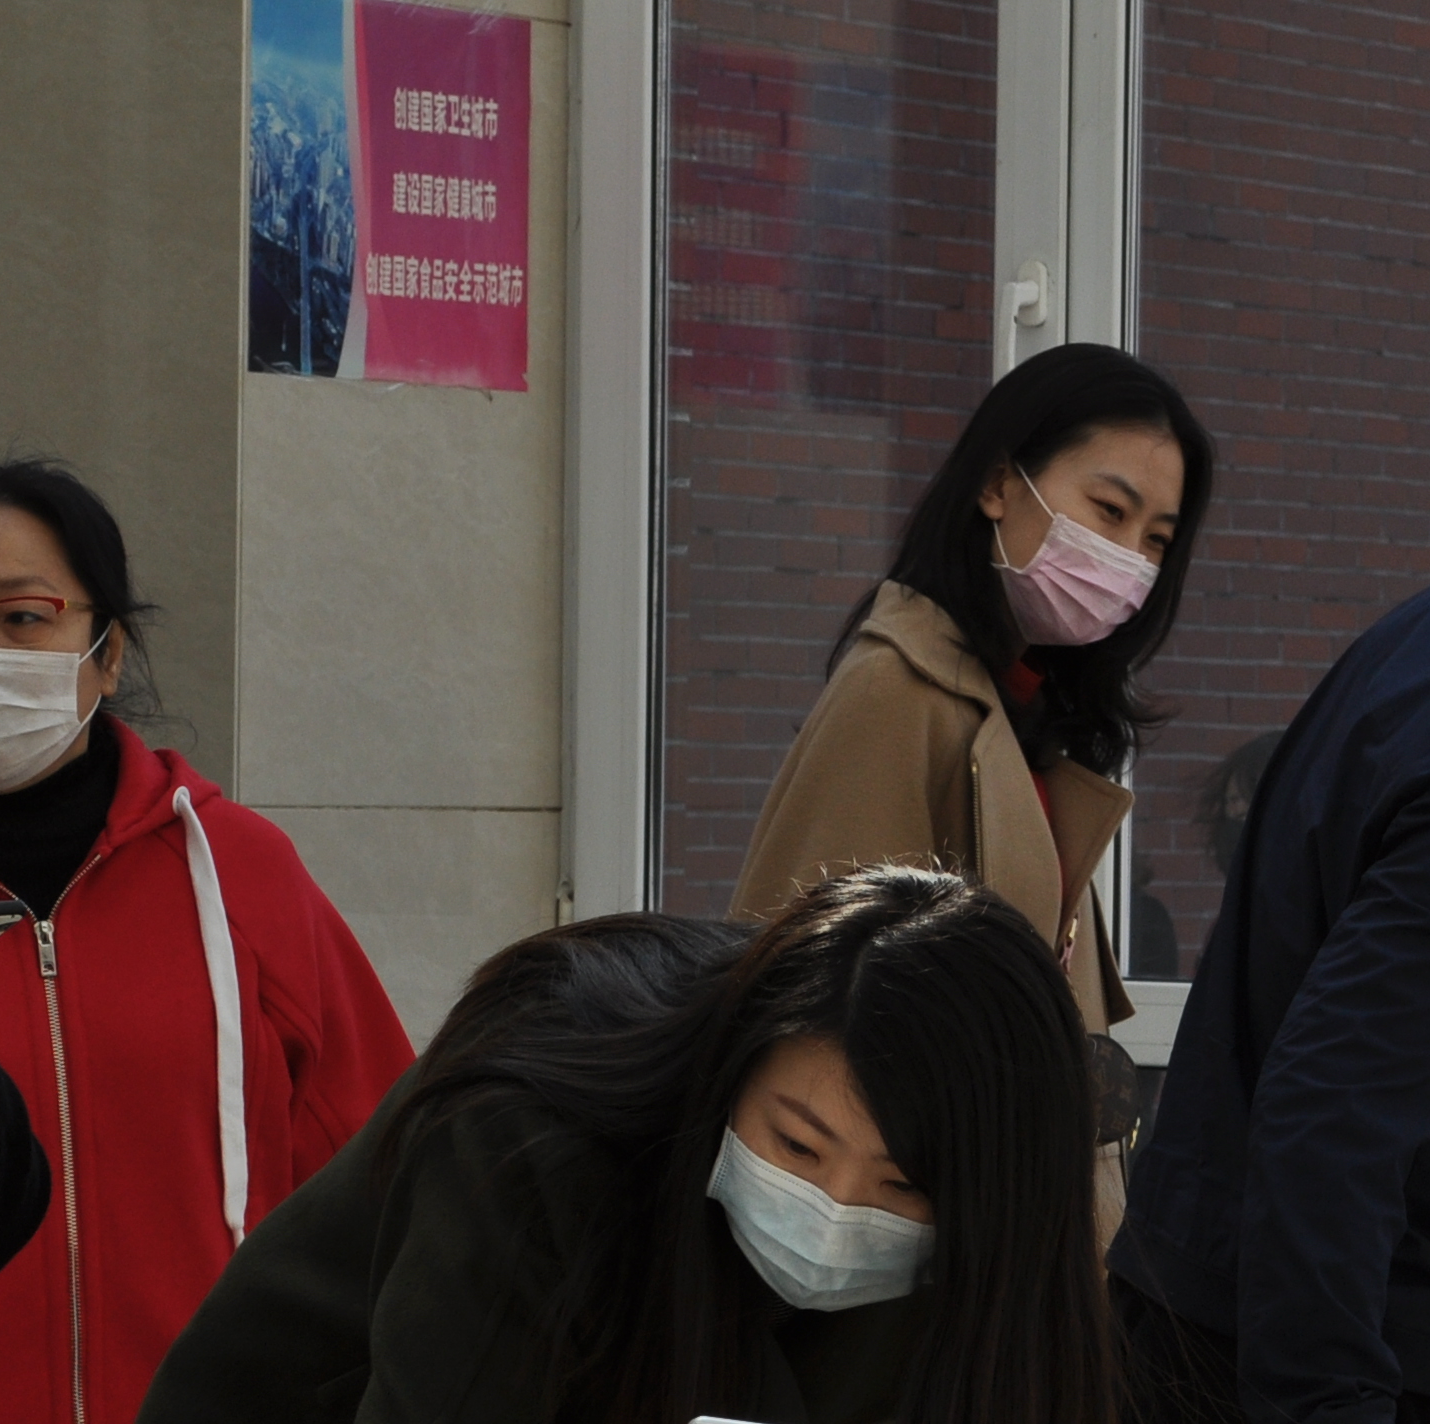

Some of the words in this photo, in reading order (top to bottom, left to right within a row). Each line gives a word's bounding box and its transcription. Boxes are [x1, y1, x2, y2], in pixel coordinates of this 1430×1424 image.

[393, 87, 499, 141] 创建国家卫生城市
[392, 172, 497, 223] 建设国家健康城市
[365, 253, 524, 308] 创建国家食品安全示范城市
